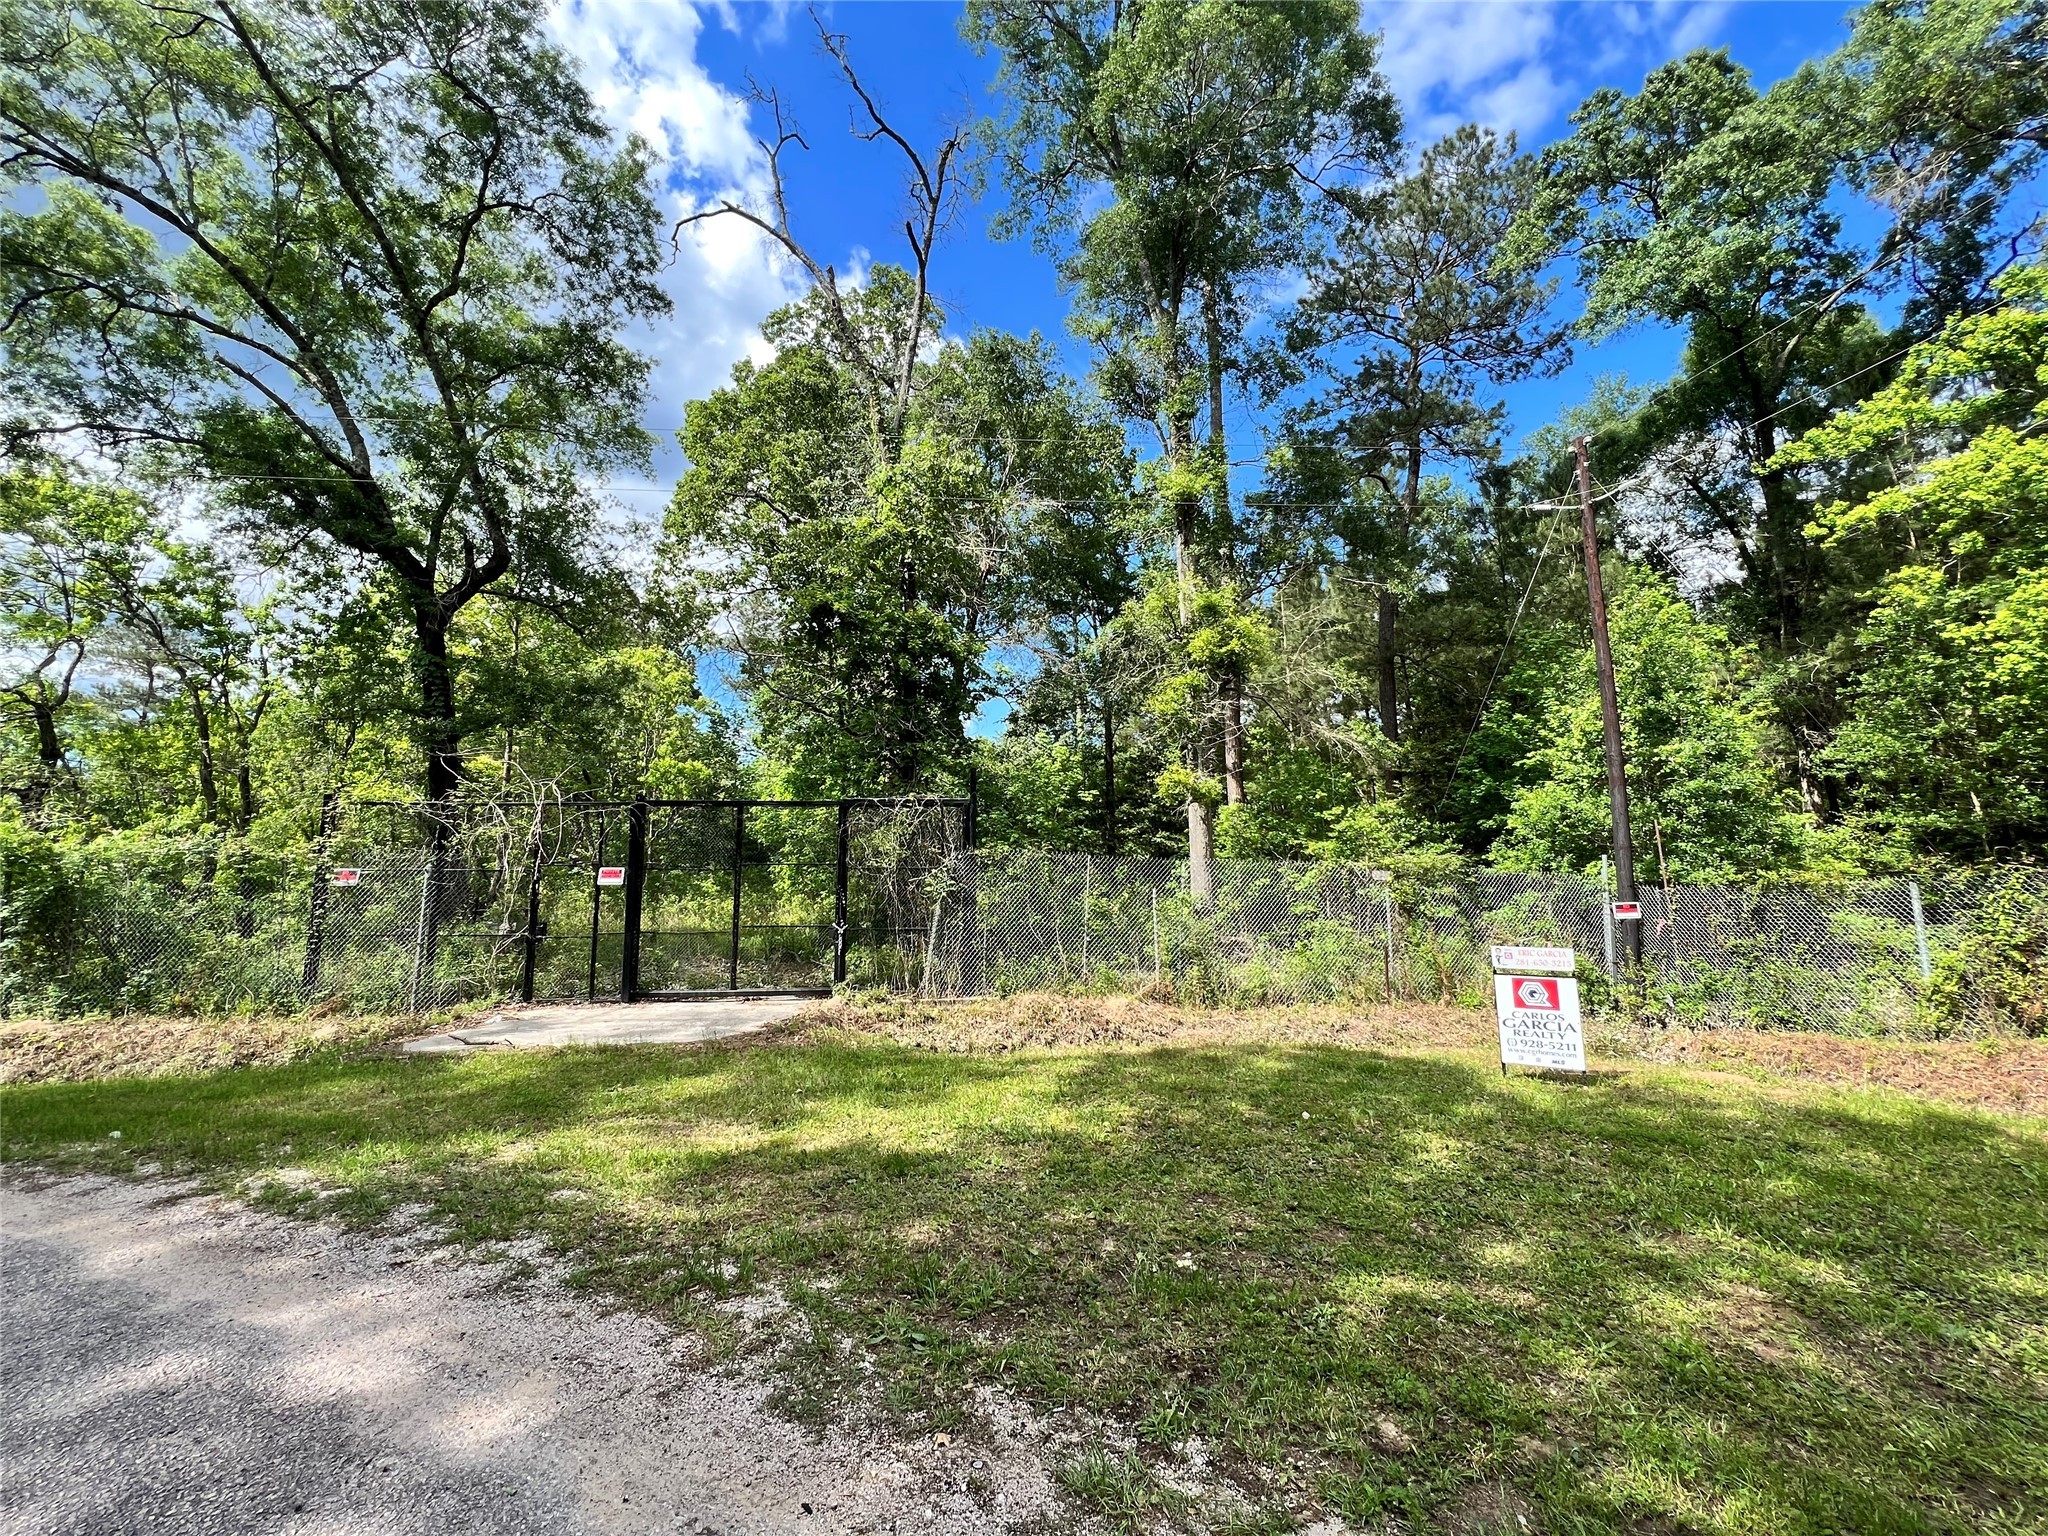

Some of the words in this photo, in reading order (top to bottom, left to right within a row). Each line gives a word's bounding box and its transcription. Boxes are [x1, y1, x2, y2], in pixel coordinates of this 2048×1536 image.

[1518, 949, 1535, 957] ERIC
[1537, 950, 1567, 958] GARCIA
[1512, 1010, 1565, 1021] CARLOS
[1502, 1018, 1577, 1033] GARCIA
[1513, 1029, 1566, 1040] REALTY
[1520, 1039, 1577, 1051] 928-5211
[1508, 1047, 1577, 1058] www.cgrhomes.com
